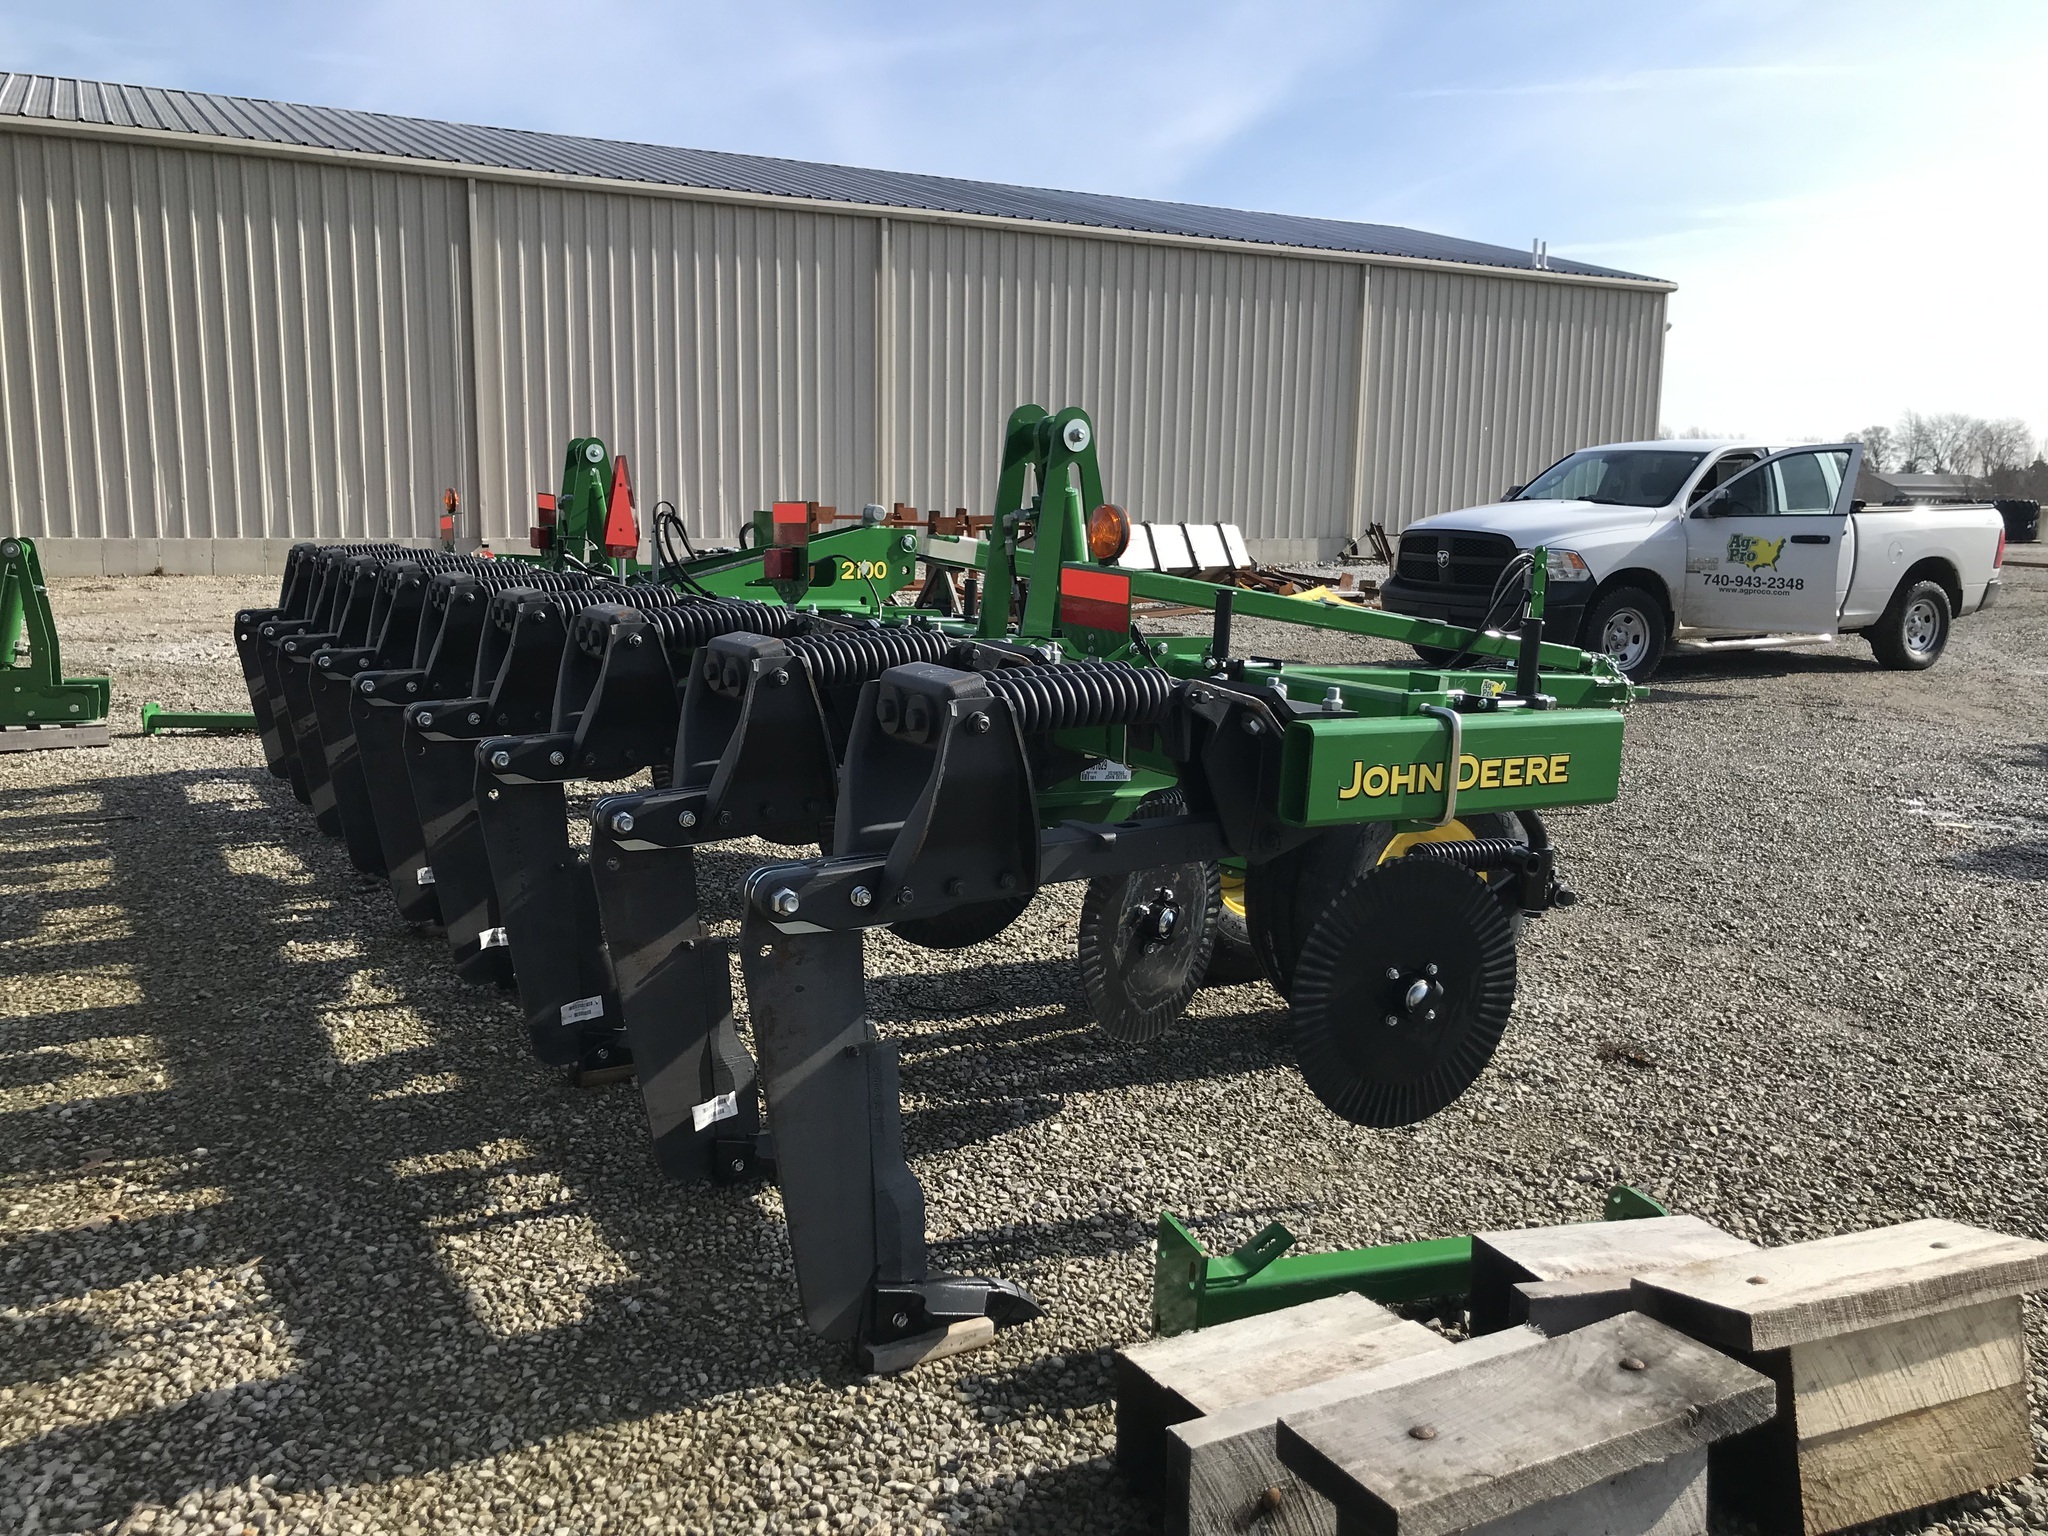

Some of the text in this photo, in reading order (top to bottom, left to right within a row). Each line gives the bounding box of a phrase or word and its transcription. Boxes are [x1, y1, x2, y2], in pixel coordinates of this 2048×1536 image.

[1729, 535, 1757, 551] Ag-
[1728, 549, 1756, 562] Pro
[841, 561, 887, 579] 2100
[1703, 574, 1804, 590] 740-943-2348
[1719, 587, 1790, 596] www.agproco.com
[1339, 754, 1570, 800] JOHN DEERE
